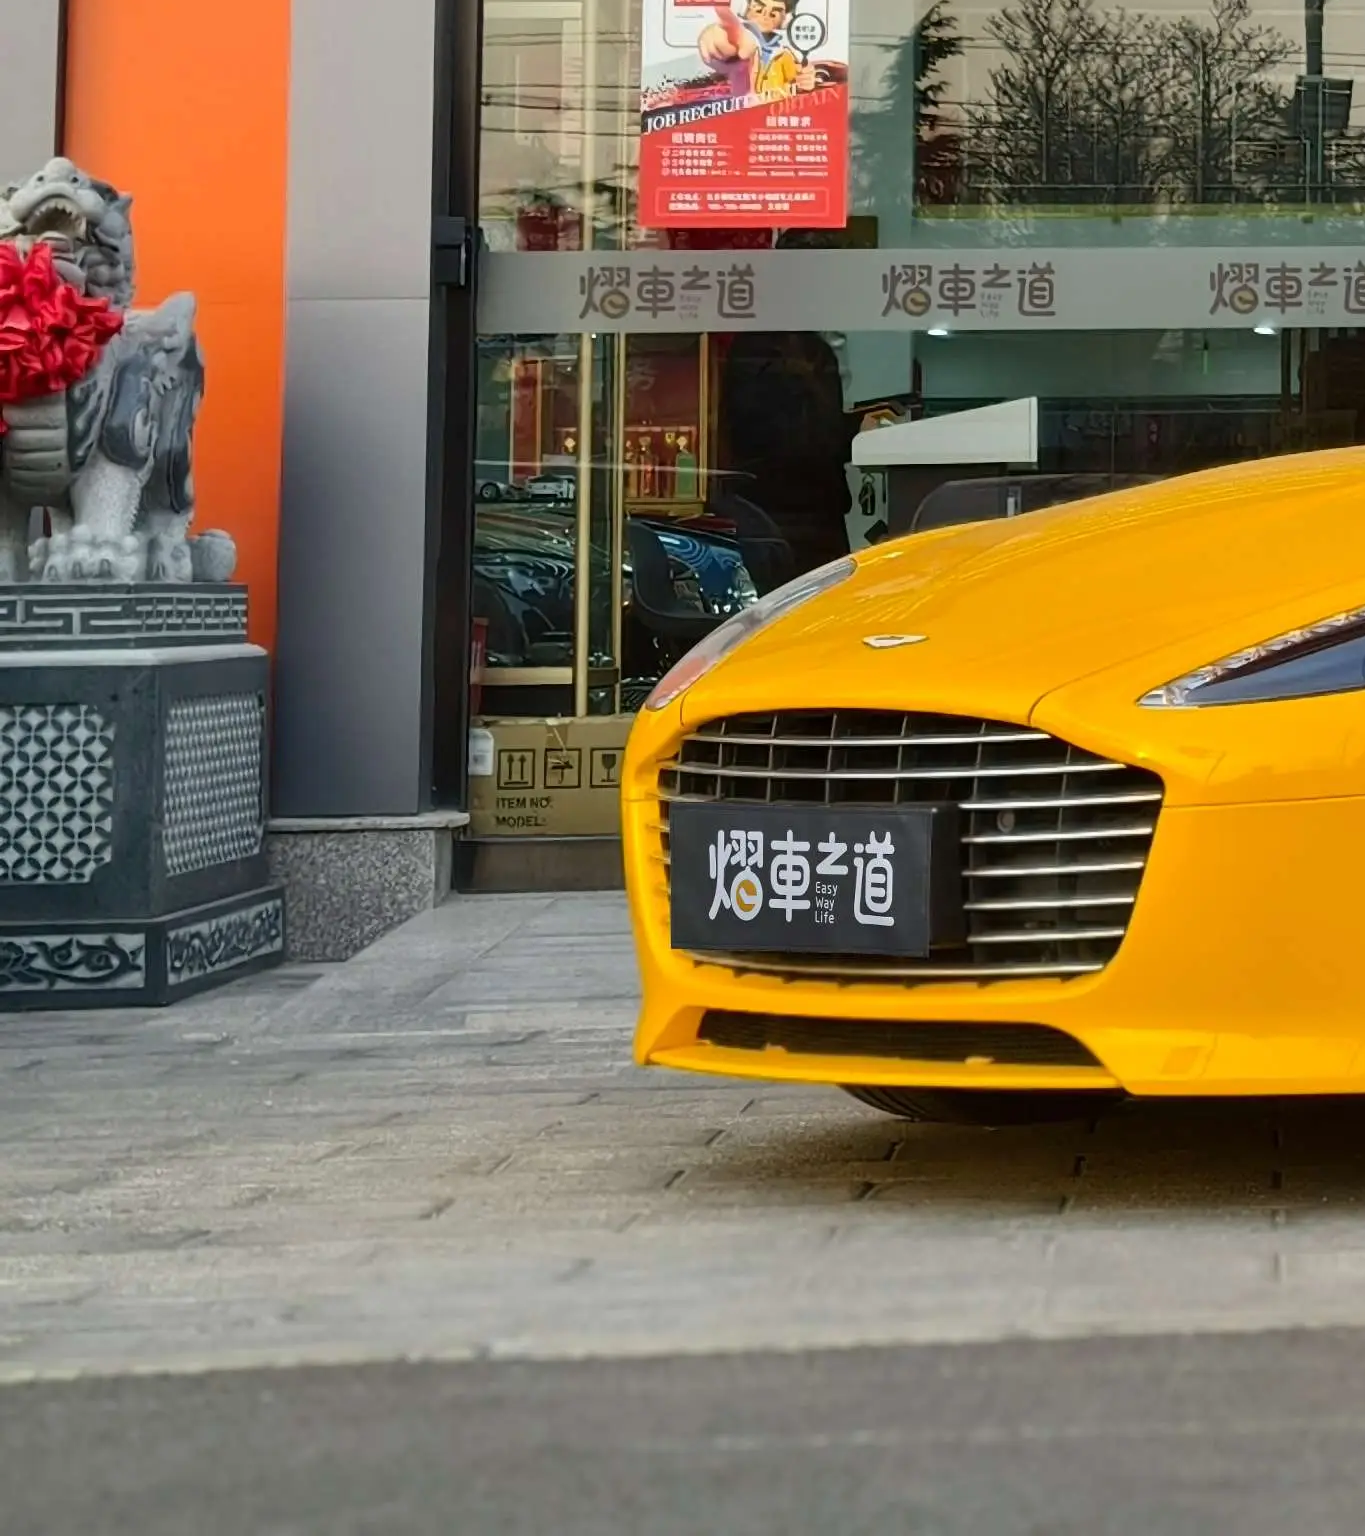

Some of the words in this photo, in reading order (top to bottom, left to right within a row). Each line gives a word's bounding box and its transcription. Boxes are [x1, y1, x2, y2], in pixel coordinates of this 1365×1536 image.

[645, 112, 676, 134] JOB
[579, 263, 756, 319] 熠車之道
[881, 261, 1056, 317] 熠車之道
[496, 797, 526, 809] ITEM
[708, 829, 895, 926] 熠車之道
[815, 881, 838, 896] Easy
[815, 898, 835, 911] Way
[814, 912, 835, 924] Life
